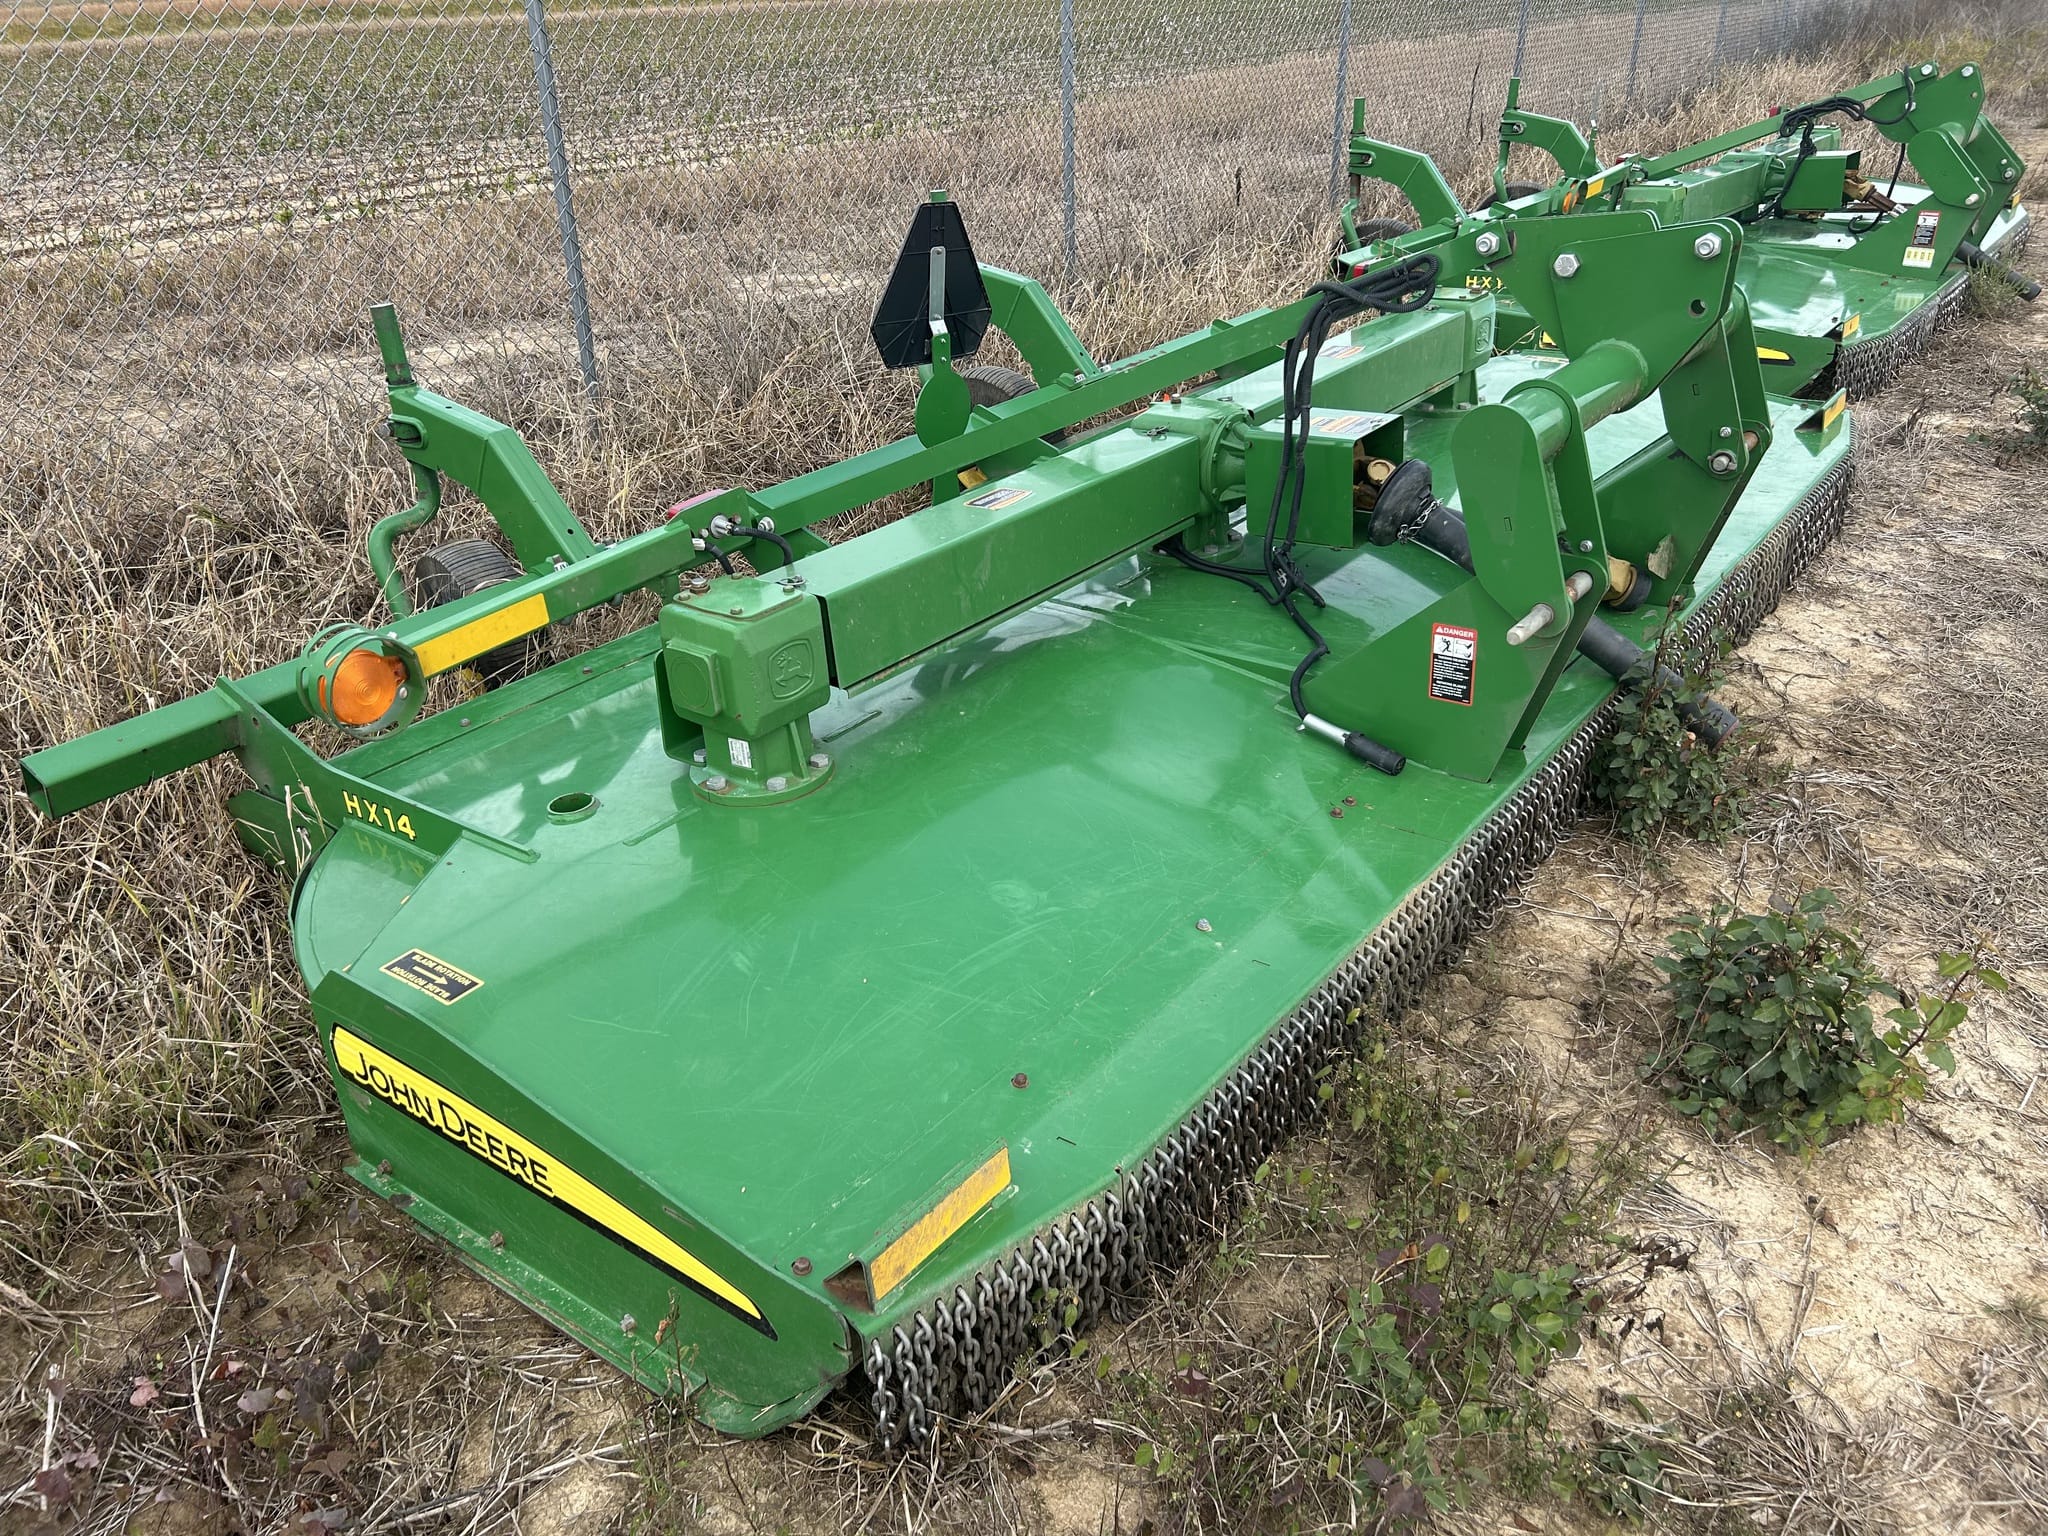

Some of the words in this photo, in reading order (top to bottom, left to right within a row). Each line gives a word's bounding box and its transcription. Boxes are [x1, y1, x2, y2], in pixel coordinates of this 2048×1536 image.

[1443, 627, 1474, 638] DANGER
[342, 790, 416, 841] HX14
[435, 965, 472, 986] ROTATION
[354, 1052, 435, 1123] JOHN
[437, 1098, 555, 1194] DEERE
